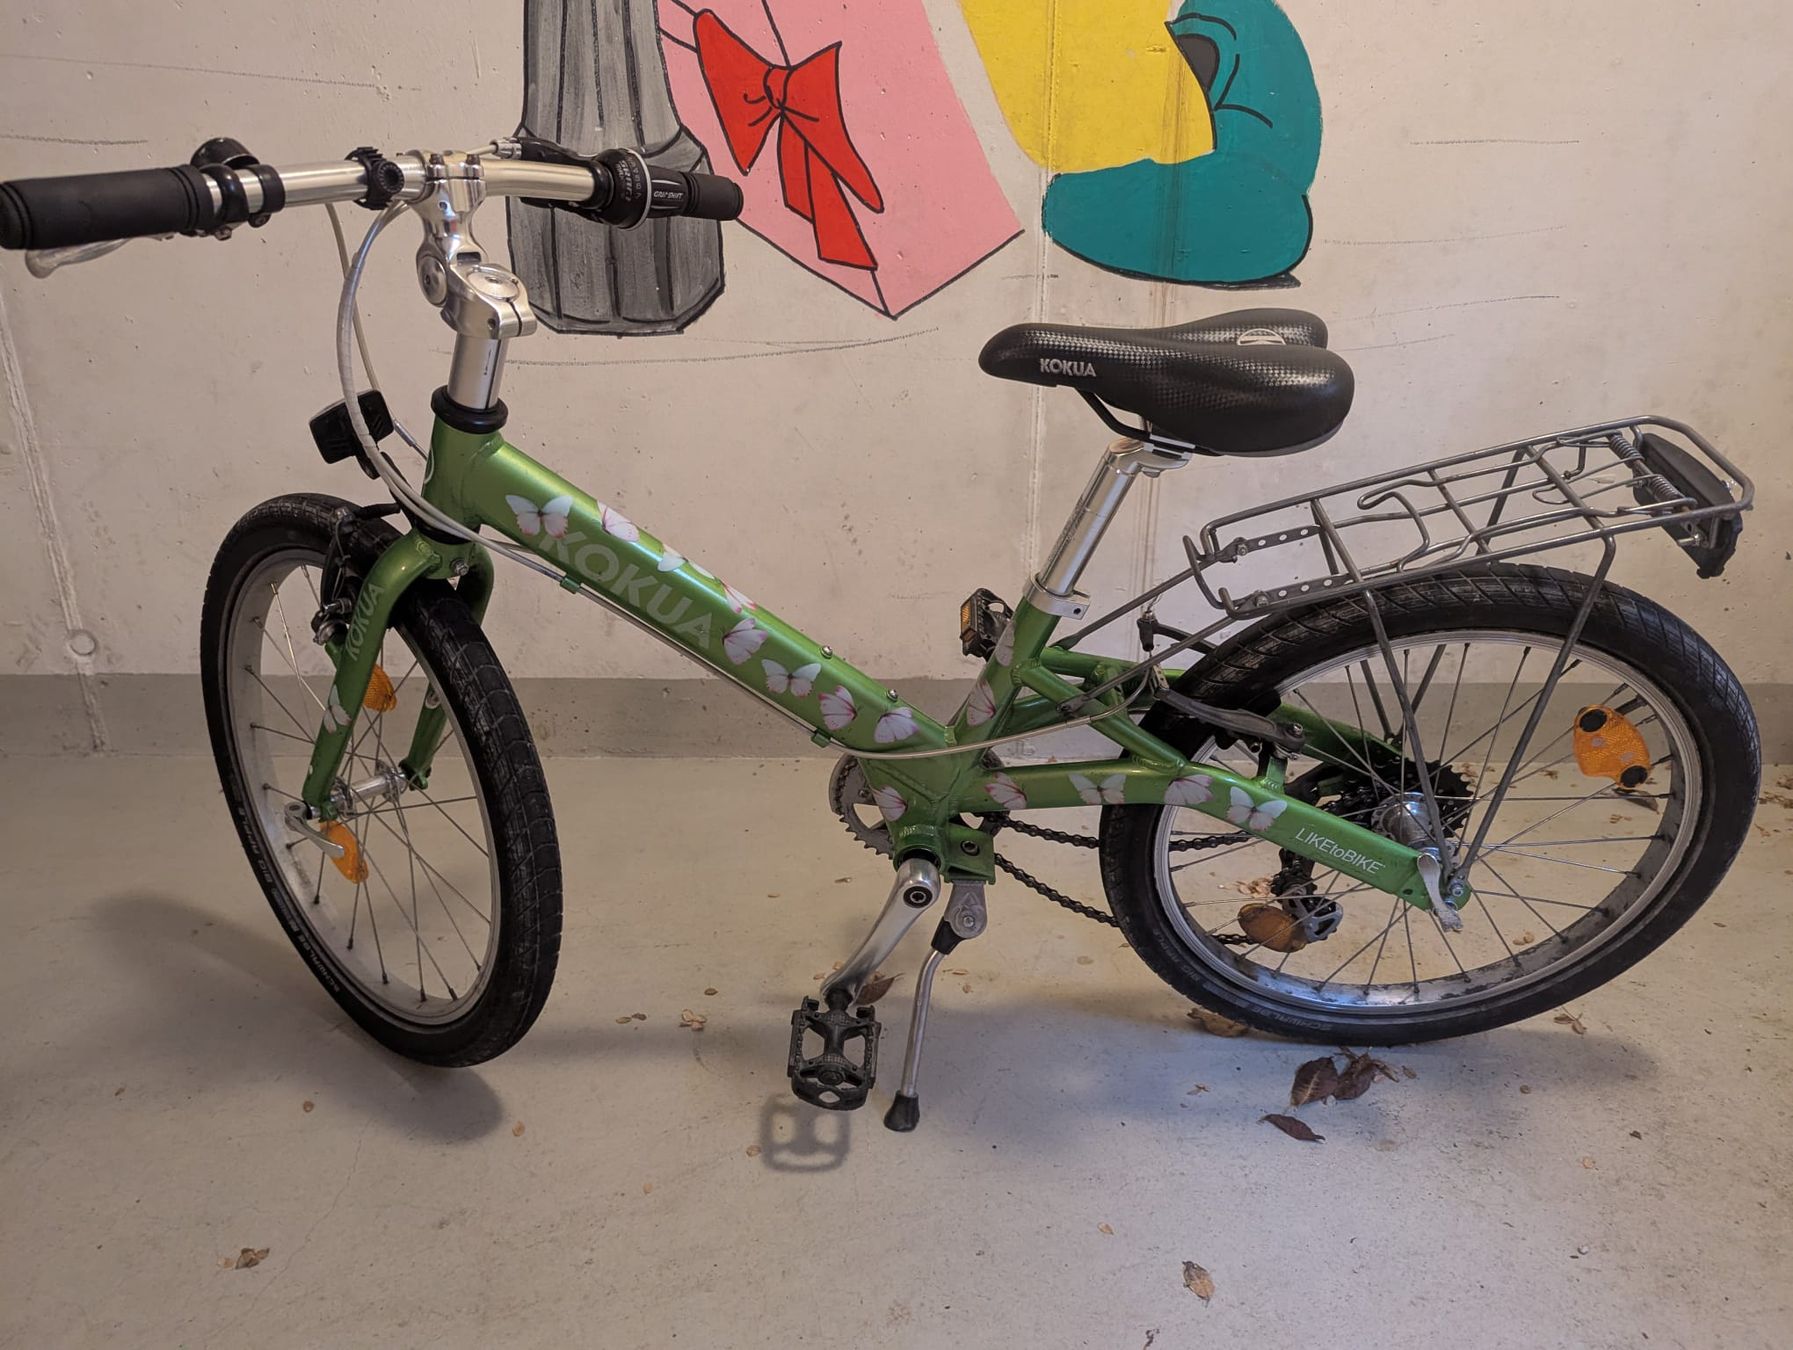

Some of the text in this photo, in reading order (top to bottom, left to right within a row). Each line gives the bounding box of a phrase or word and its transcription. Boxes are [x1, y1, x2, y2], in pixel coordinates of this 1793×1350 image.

[1040, 358, 1097, 377] KOKUA
[538, 531, 712, 650] KOKUA
[345, 584, 385, 661] KOKUA
[1295, 828, 1386, 874] LIKEtoBIKE
